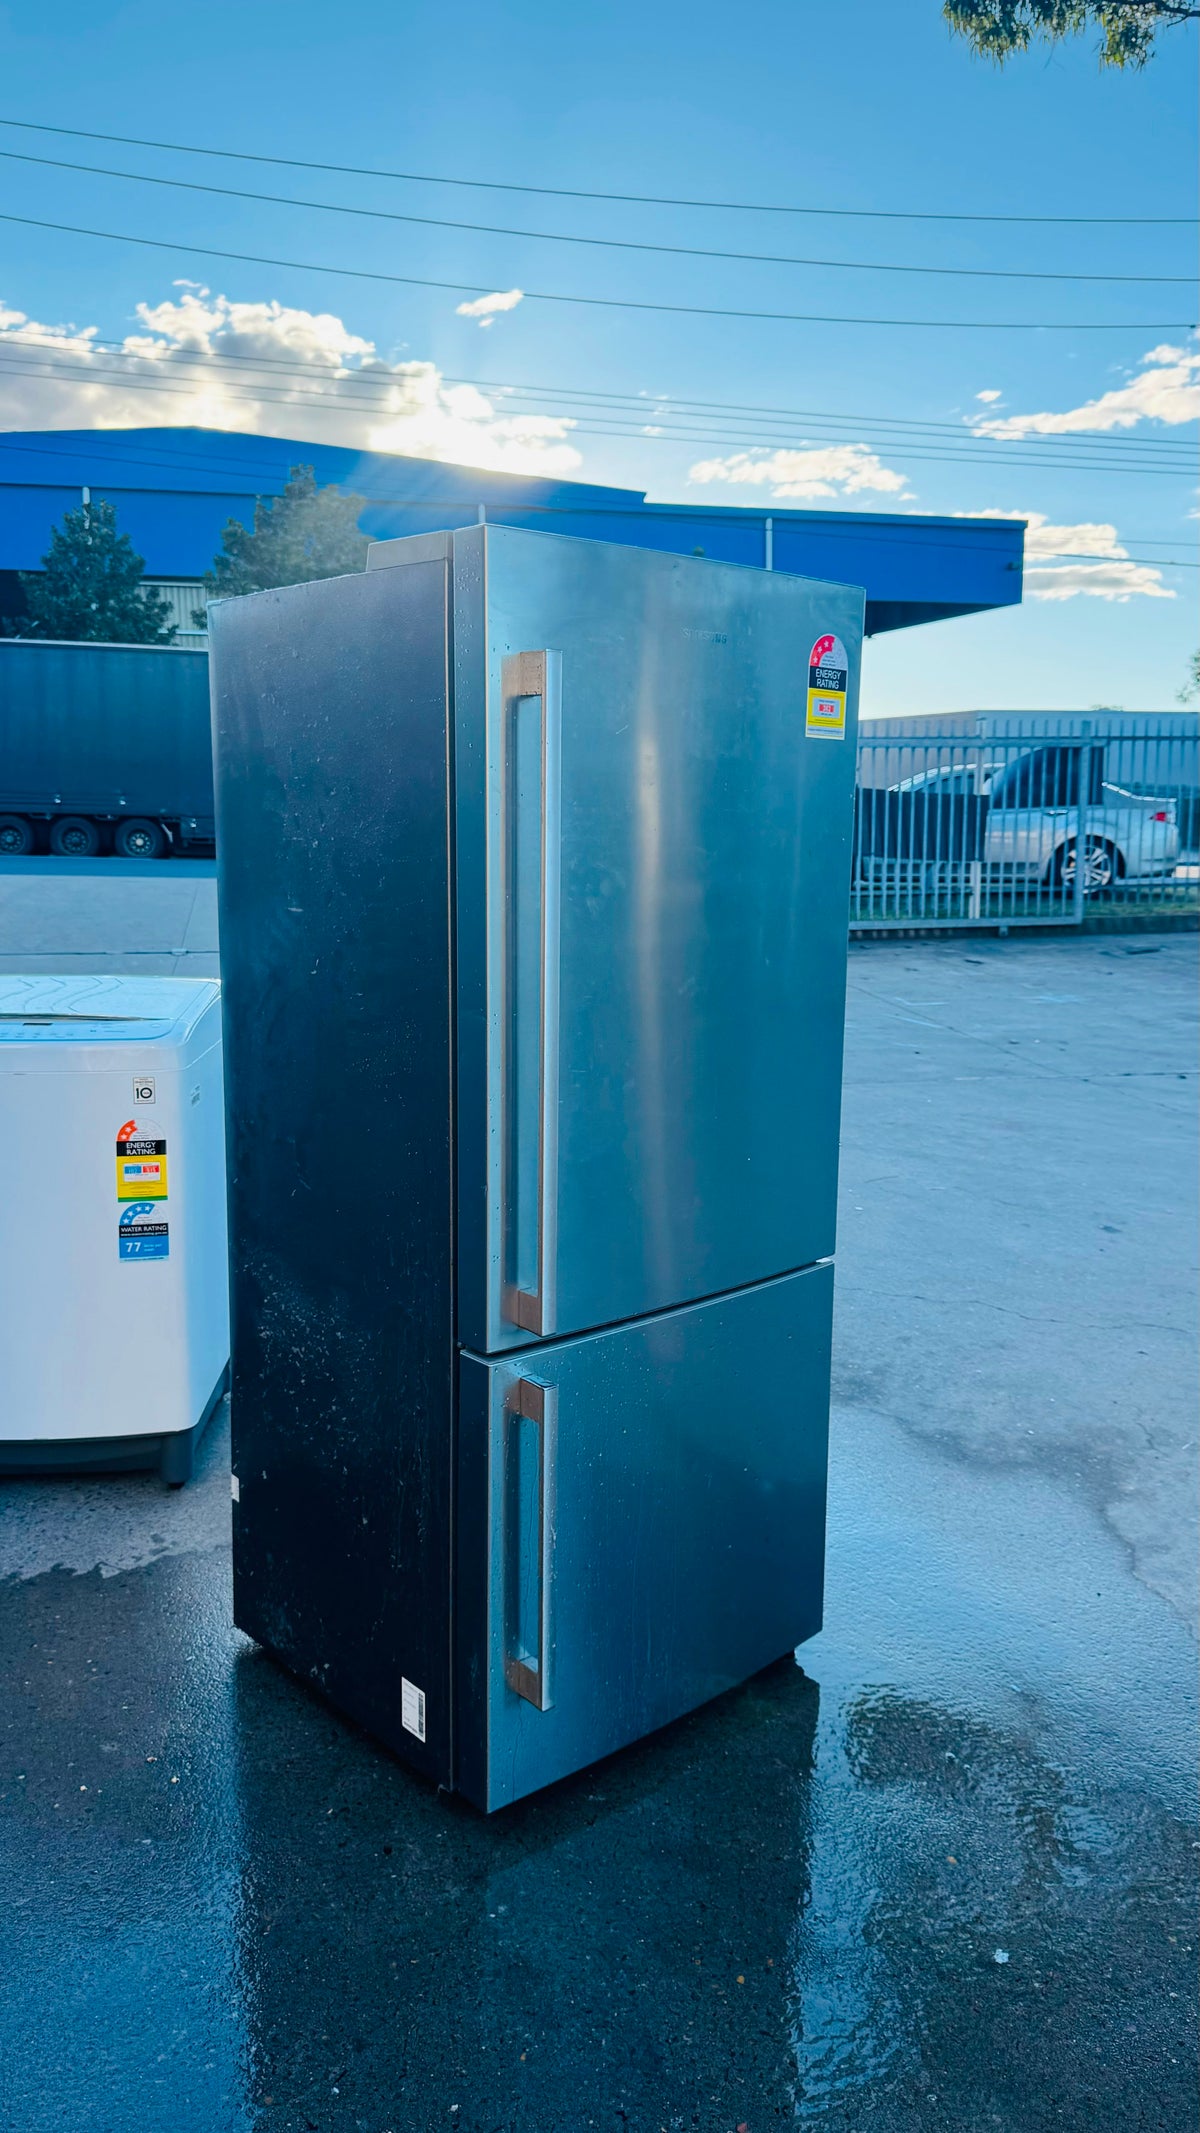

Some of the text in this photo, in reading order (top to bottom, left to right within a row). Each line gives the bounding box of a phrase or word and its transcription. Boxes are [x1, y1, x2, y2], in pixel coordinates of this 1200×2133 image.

[816, 668, 842, 680] ENERGY
[816, 679, 840, 690] RATING
[136, 1087, 153, 1099] 10
[126, 1141, 157, 1150] ENERGY
[126, 1147, 156, 1156] RATING
[143, 1224, 167, 1232] RATING
[126, 1242, 142, 1253] 77
